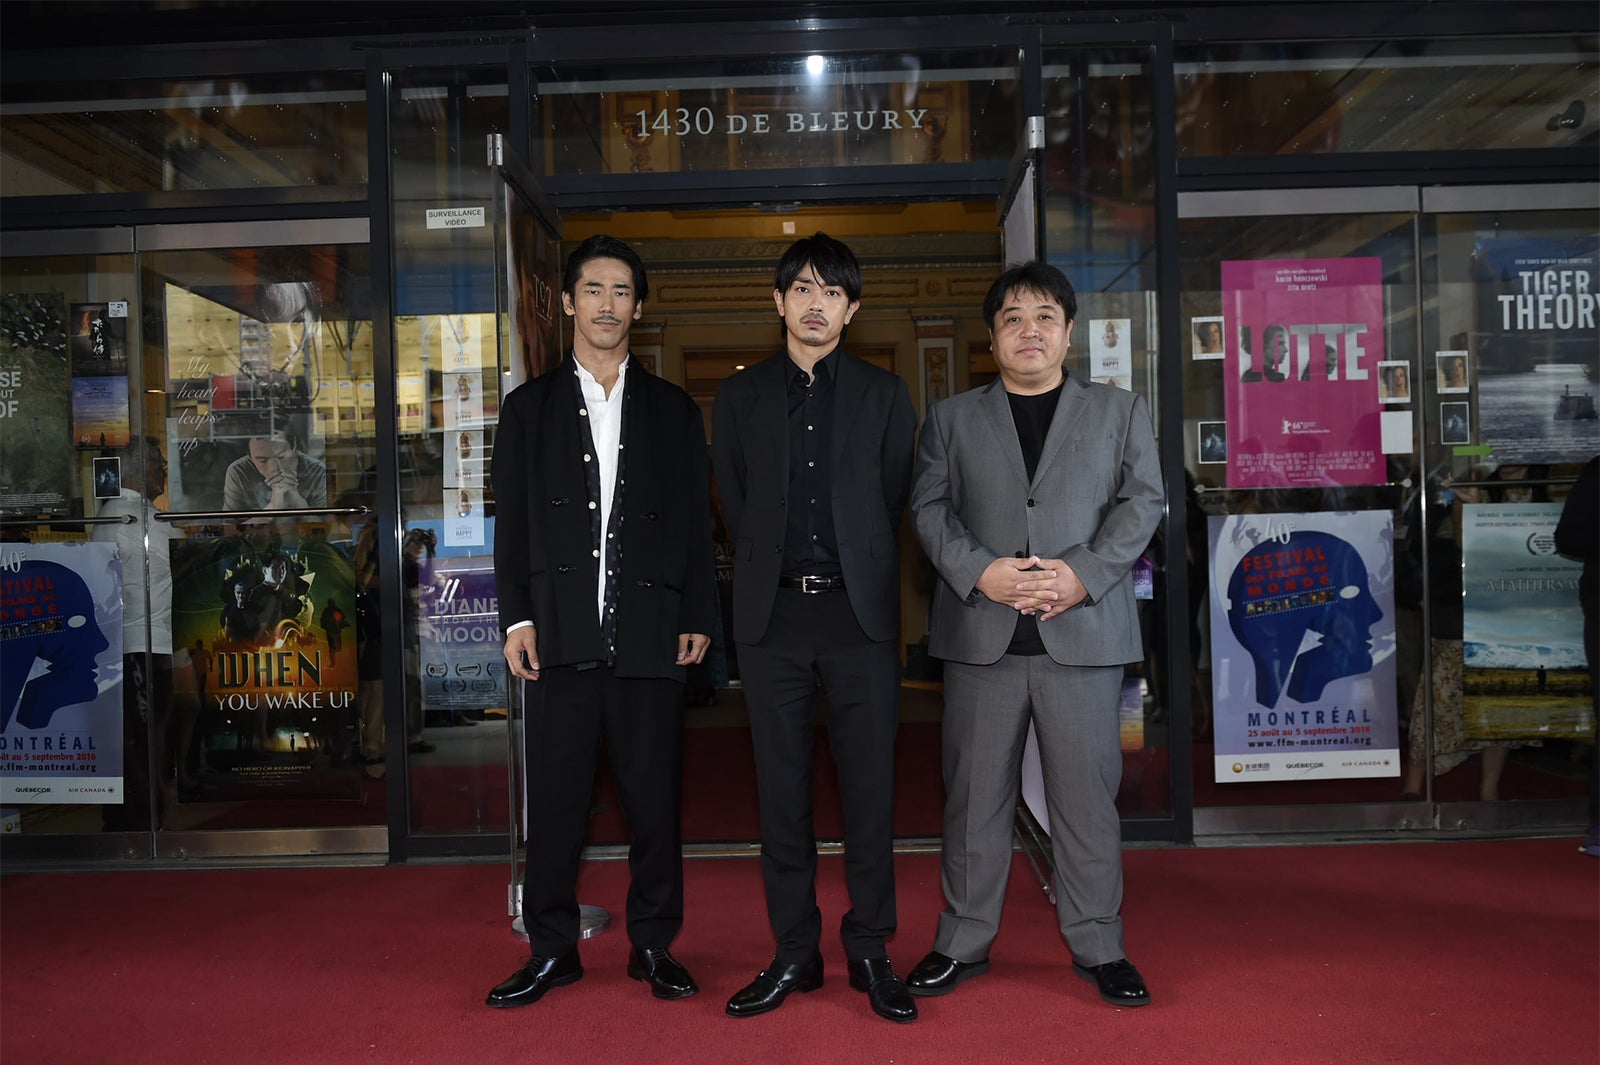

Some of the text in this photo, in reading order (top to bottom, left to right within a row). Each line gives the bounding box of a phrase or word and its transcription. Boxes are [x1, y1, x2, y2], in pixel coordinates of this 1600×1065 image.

[636, 107, 929, 137] 1430 DE BLEURY
[428, 209, 482, 218] SURVEILLANCE
[1518, 270, 1590, 295] TIGER
[1238, 323, 1369, 383] LOTTE
[177, 355, 210, 379] My
[176, 382, 218, 399] heart
[178, 408, 218, 431] leaps
[178, 437, 198, 457] up
[1242, 546, 1327, 574] FESTIVAL
[1269, 565, 1308, 580] FILMS
[1248, 575, 1330, 597] MONDE
[434, 598, 498, 615] DIANE
[435, 626, 501, 643] MOON
[218, 650, 322, 688] WHEN
[214, 691, 355, 711] YOU WAKE UP
[1247, 706, 1371, 727] MONTRÉAL
[1248, 729, 1258, 737] 25
[1304, 727, 1347, 737] septembre
[1350, 726, 1371, 734] 2016
[1248, 736, 1372, 748] www.ffm-montreal.org
[24, 753, 30, 761] 5
[32, 753, 74, 762] septembre
[77, 752, 97, 761] 2016
